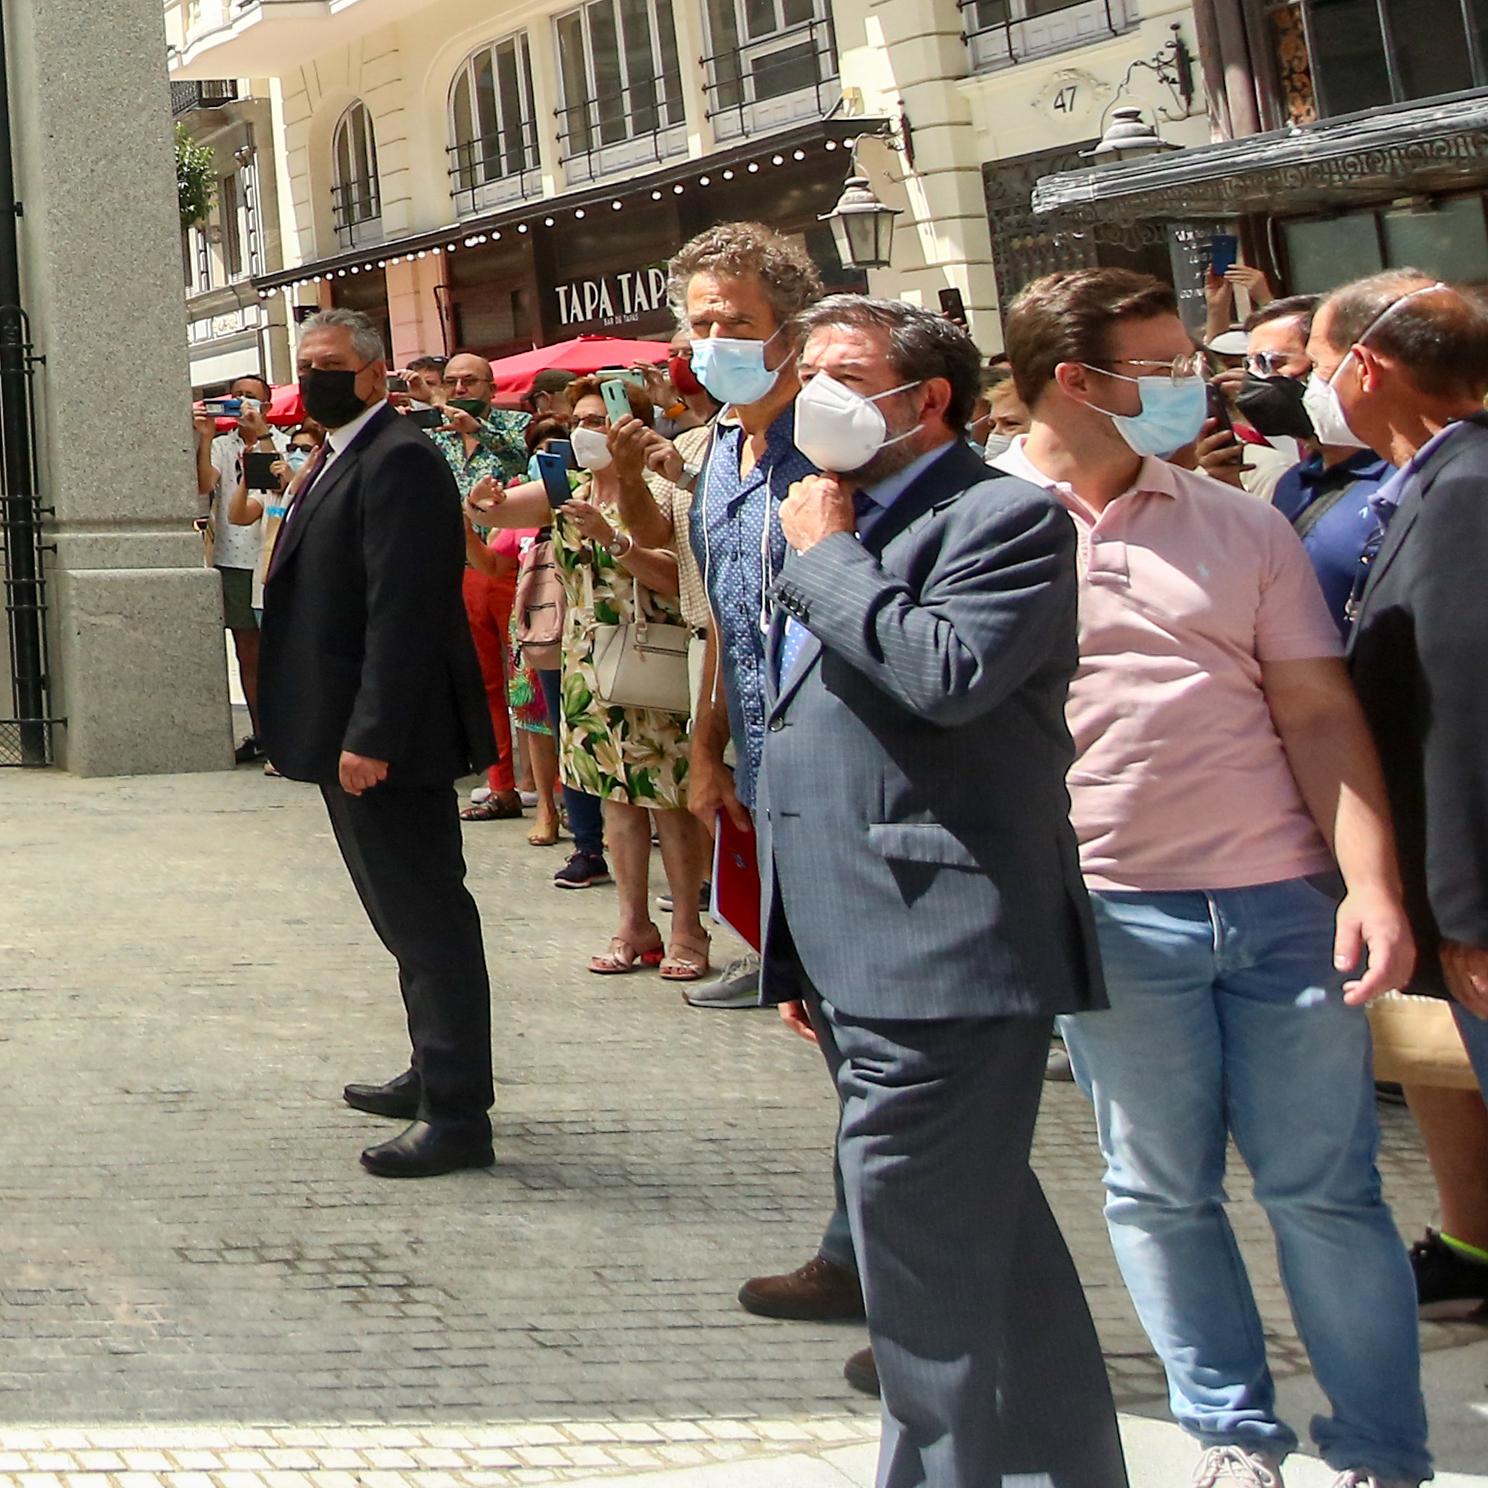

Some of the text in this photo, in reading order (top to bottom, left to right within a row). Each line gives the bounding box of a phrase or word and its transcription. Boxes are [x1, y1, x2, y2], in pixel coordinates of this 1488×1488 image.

[1053, 85, 1078, 113] 47
[554, 267, 670, 325] TAPA TAP
[604, 313, 639, 326] BAR DE TAPAS
